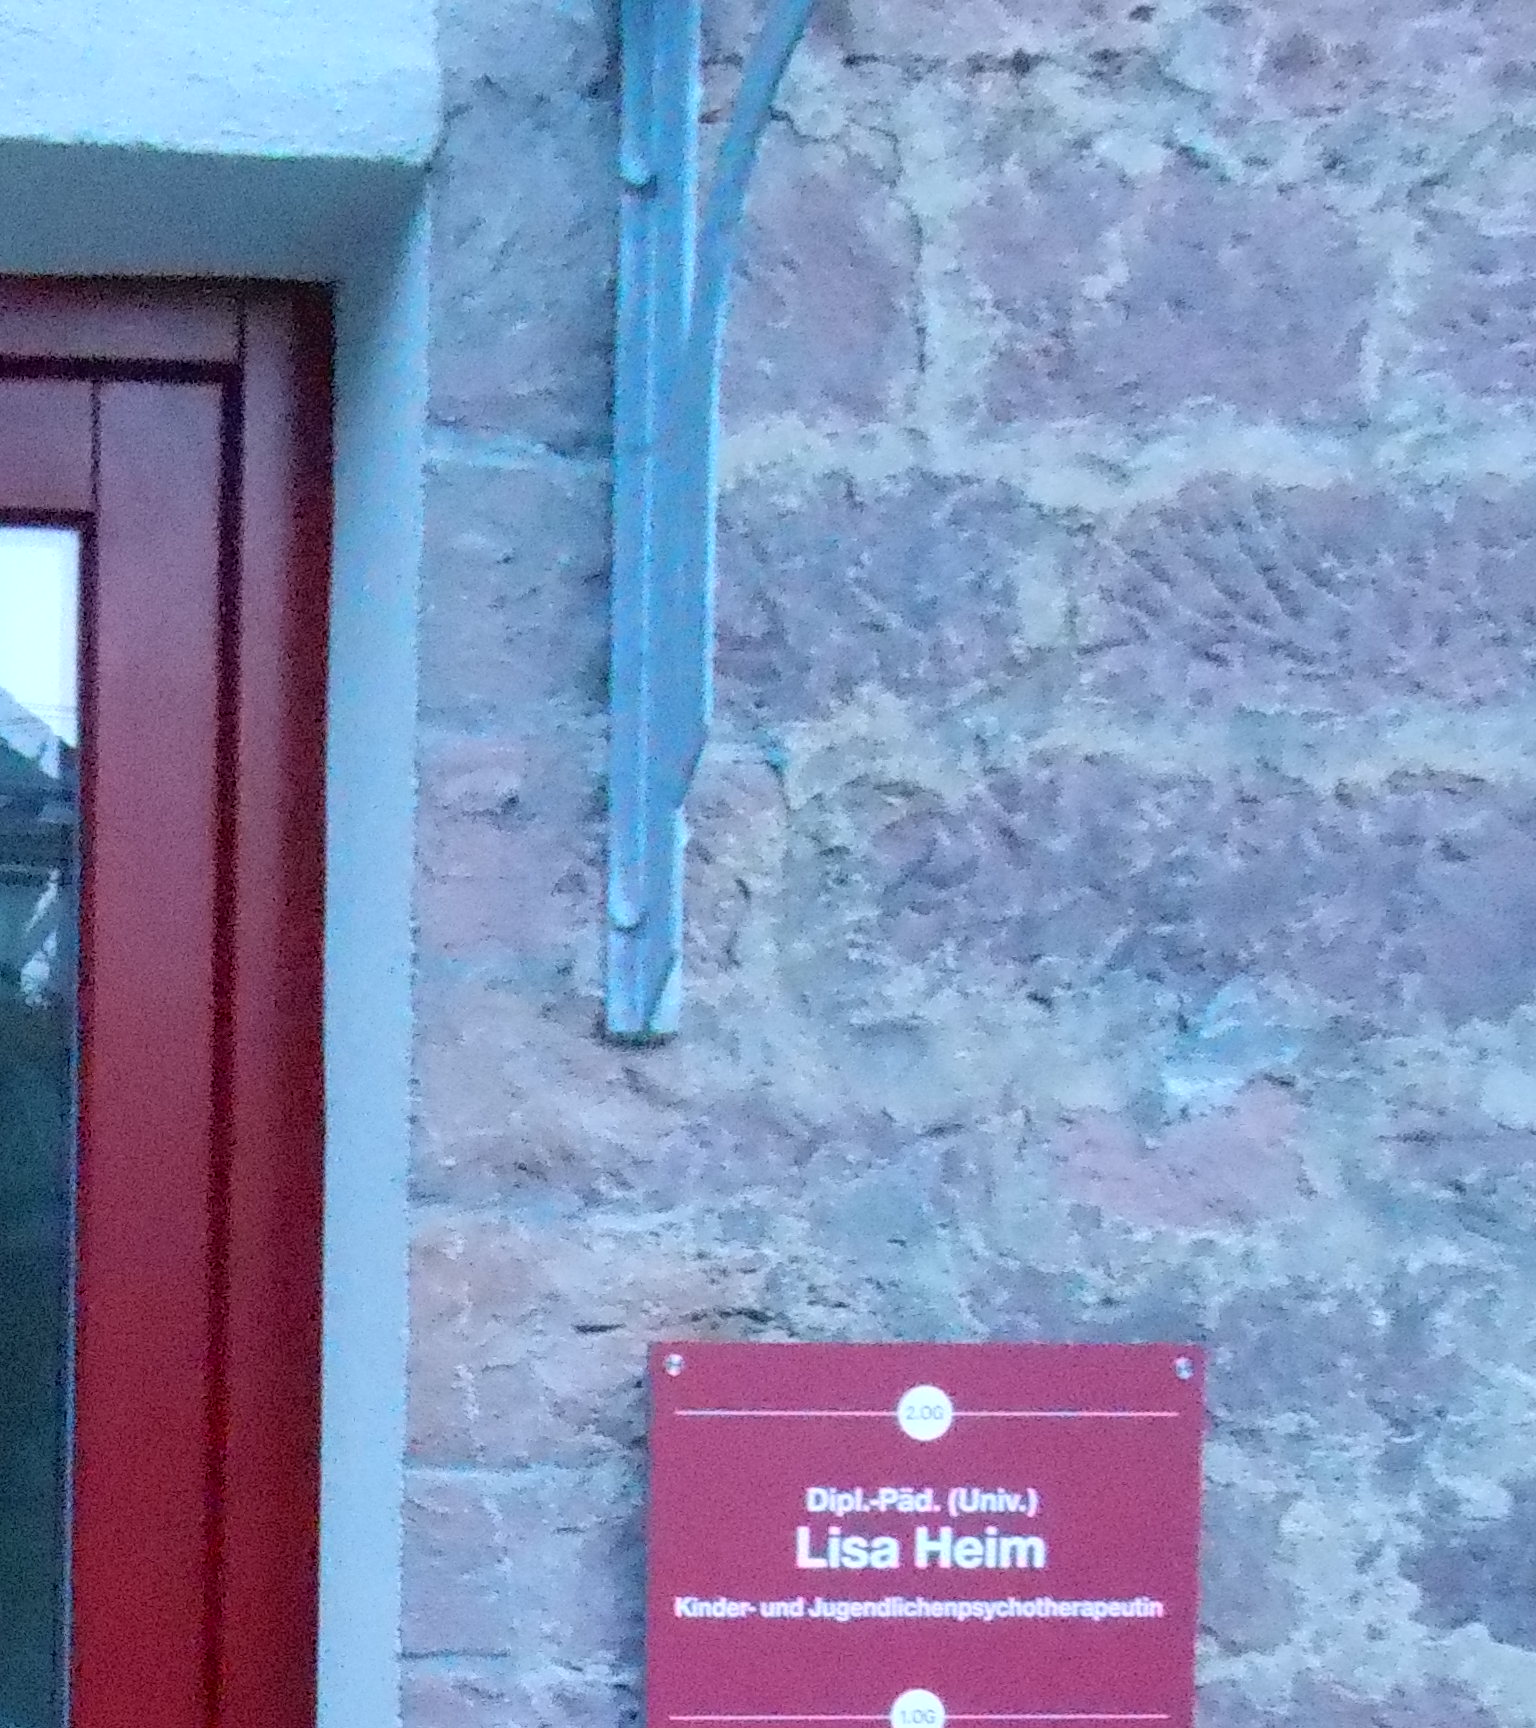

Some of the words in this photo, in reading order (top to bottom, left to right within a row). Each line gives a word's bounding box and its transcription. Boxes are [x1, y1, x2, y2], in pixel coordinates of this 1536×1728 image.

[805, 1486, 941, 1517] Dipl.-Päd.
[947, 1486, 1040, 1517] (Univ.)
[795, 1525, 901, 1570] Lisa
[913, 1525, 1047, 1570] Heim
[674, 1596, 756, 1619] Kinder-
[760, 1597, 805, 1619] und
[808, 1596, 1165, 1622] Jugendlichenpsychotherapeutin
